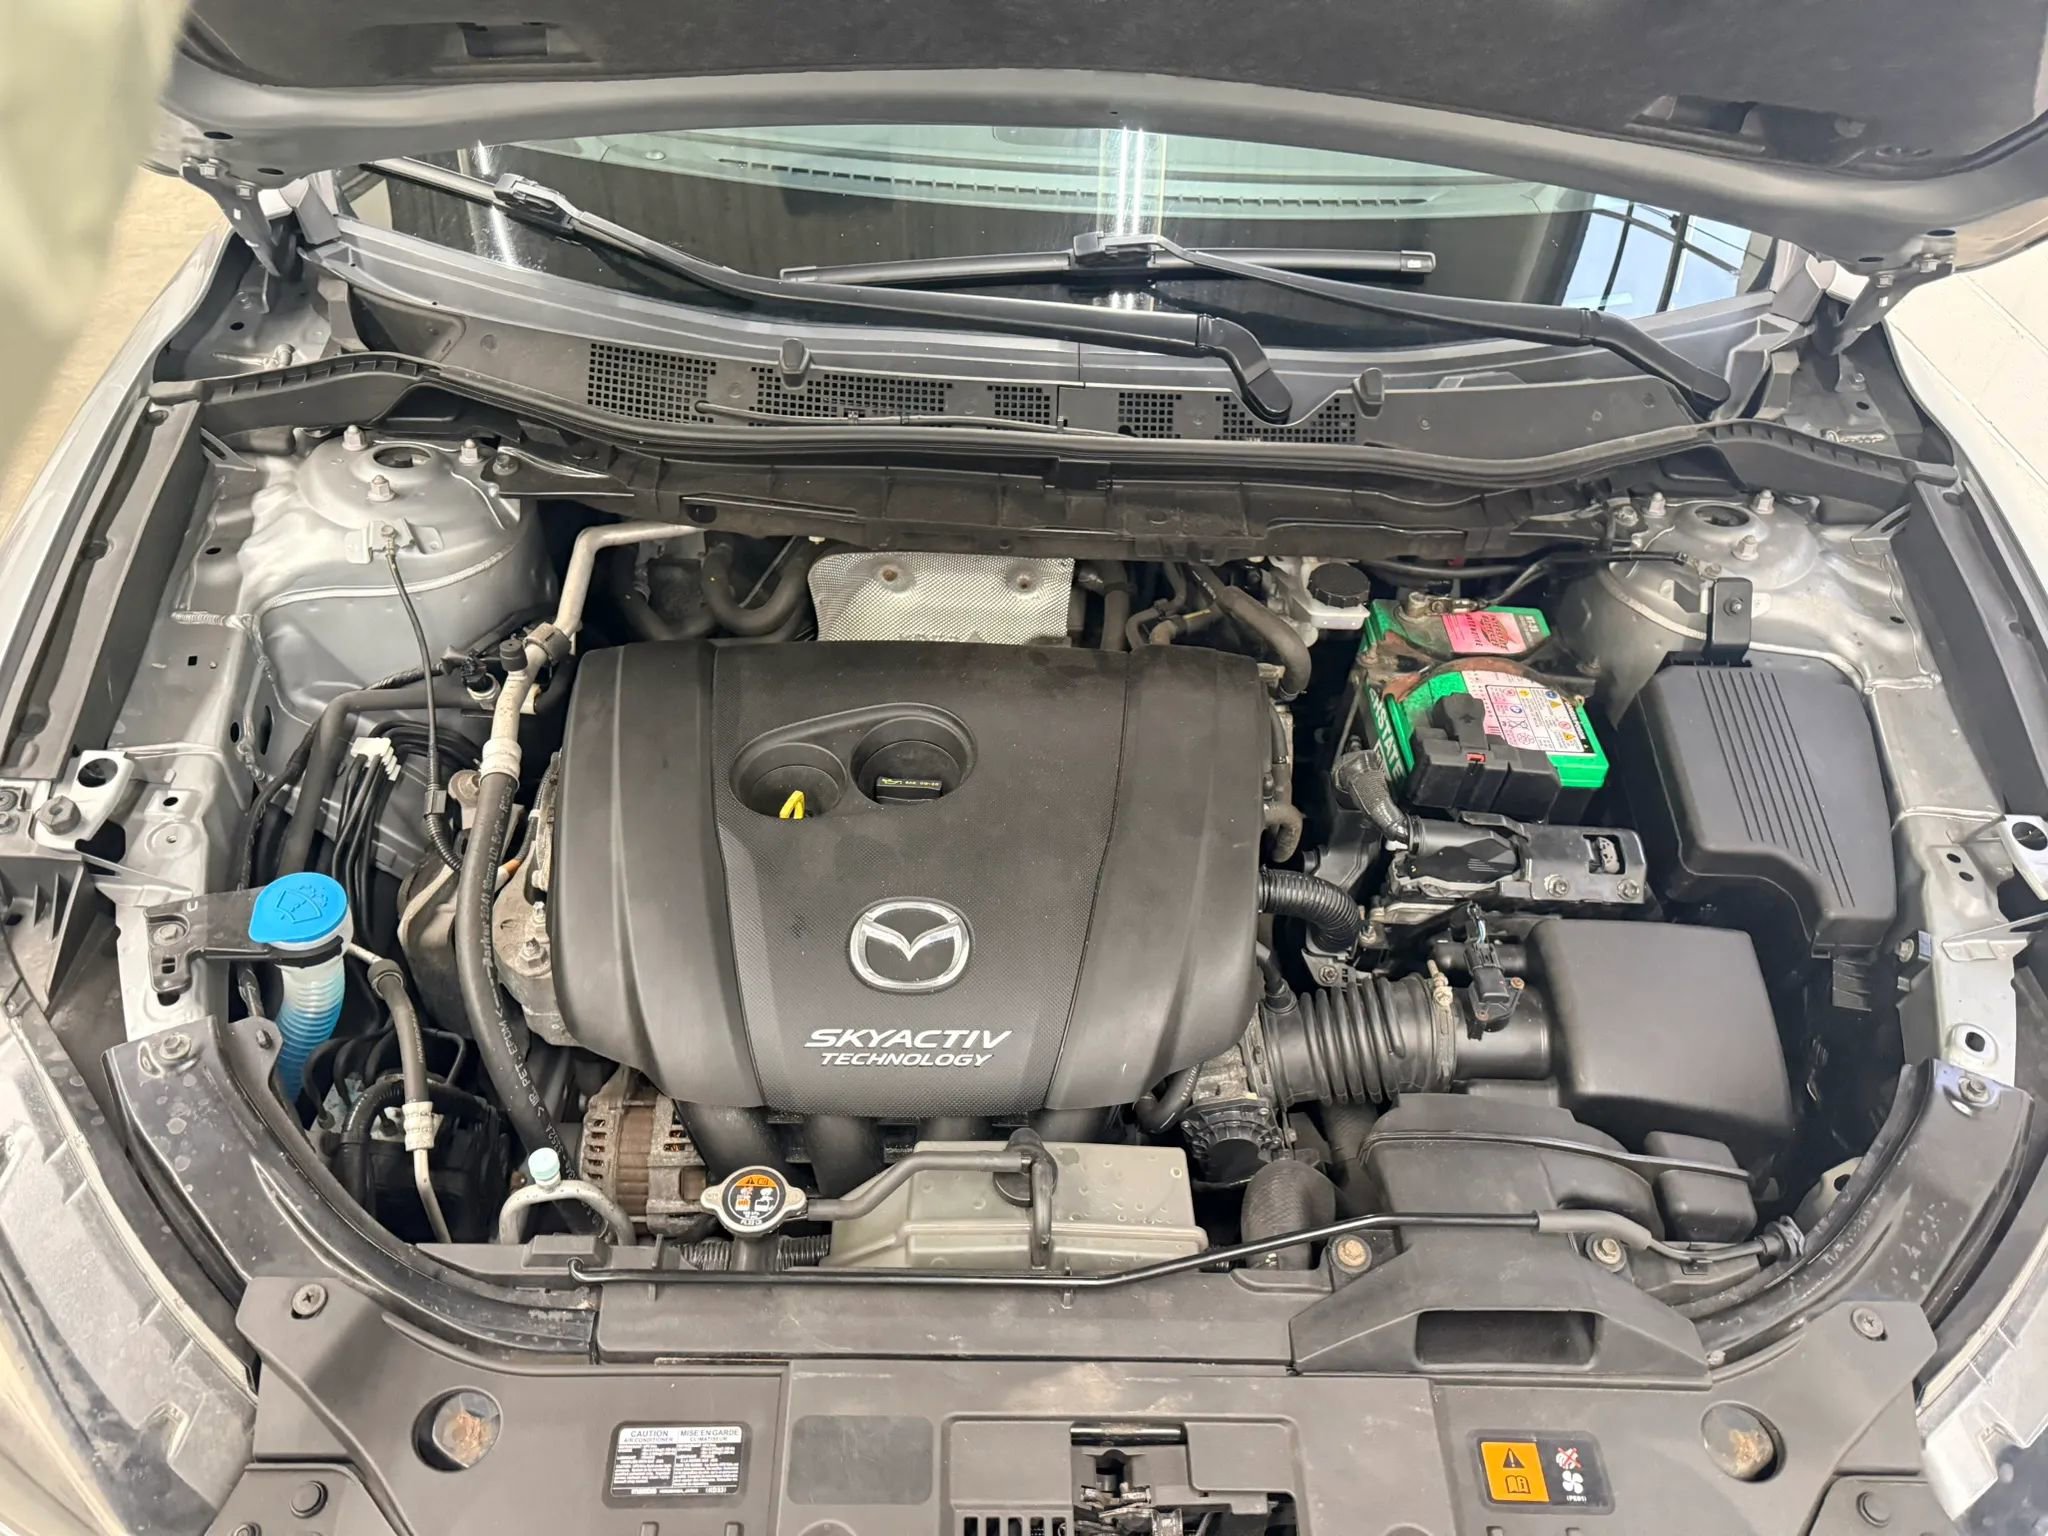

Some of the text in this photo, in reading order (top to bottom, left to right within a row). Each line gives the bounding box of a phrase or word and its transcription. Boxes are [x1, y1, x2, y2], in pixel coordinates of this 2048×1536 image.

[804, 1028, 1013, 1049] SKYACTIV
[820, 1052, 994, 1067] TECHNOLOGY
[680, 1429, 698, 1437] MISE
[700, 1429, 711, 1437] EN
